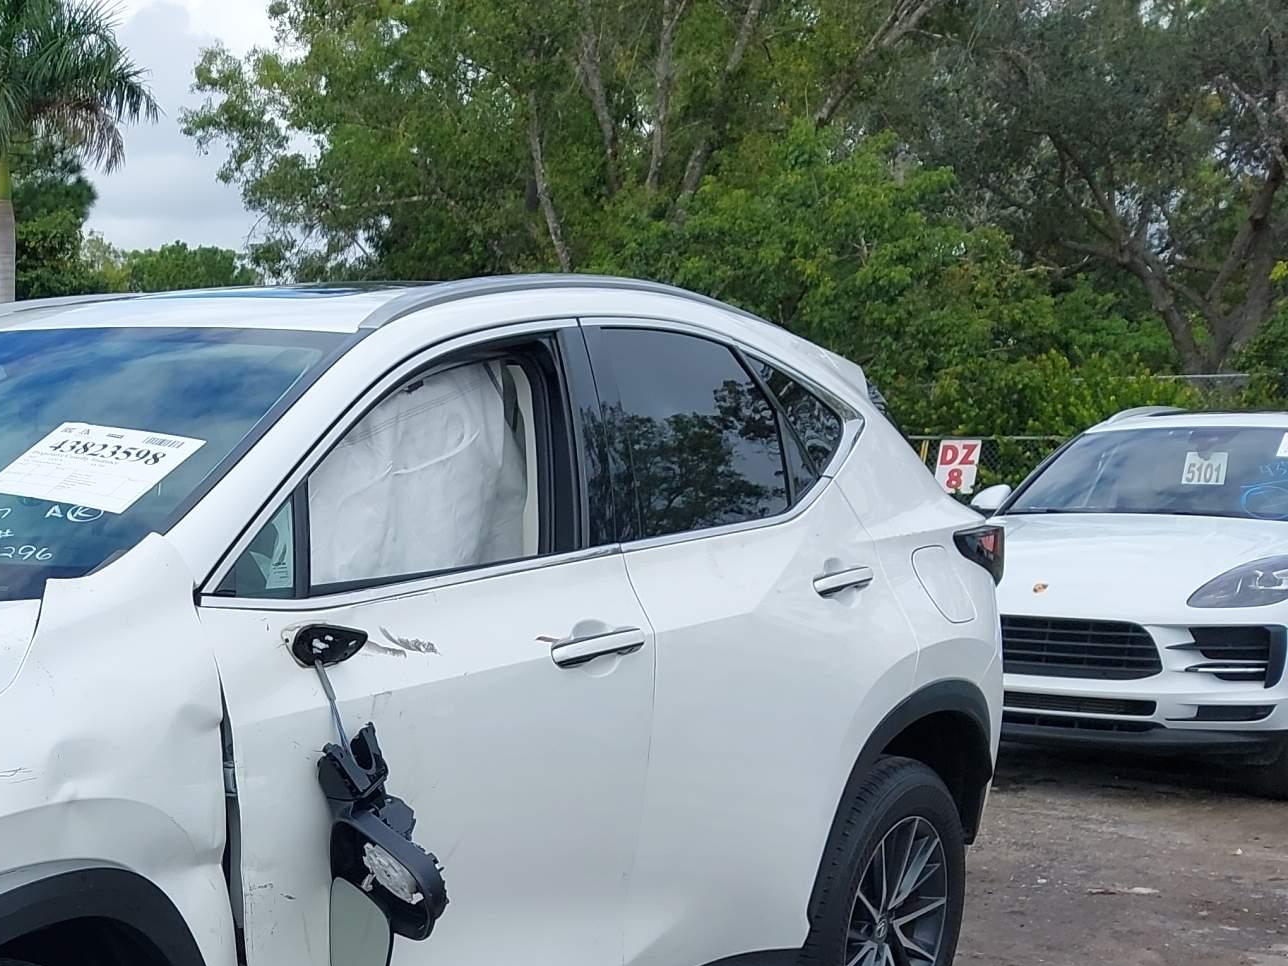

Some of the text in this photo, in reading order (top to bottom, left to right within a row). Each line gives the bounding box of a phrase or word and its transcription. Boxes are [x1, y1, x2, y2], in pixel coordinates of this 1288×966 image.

[49, 439, 167, 466] 43823598
[940, 444, 978, 465] DZ
[946, 468, 963, 488] 8
[1186, 462, 1223, 483] 5101
